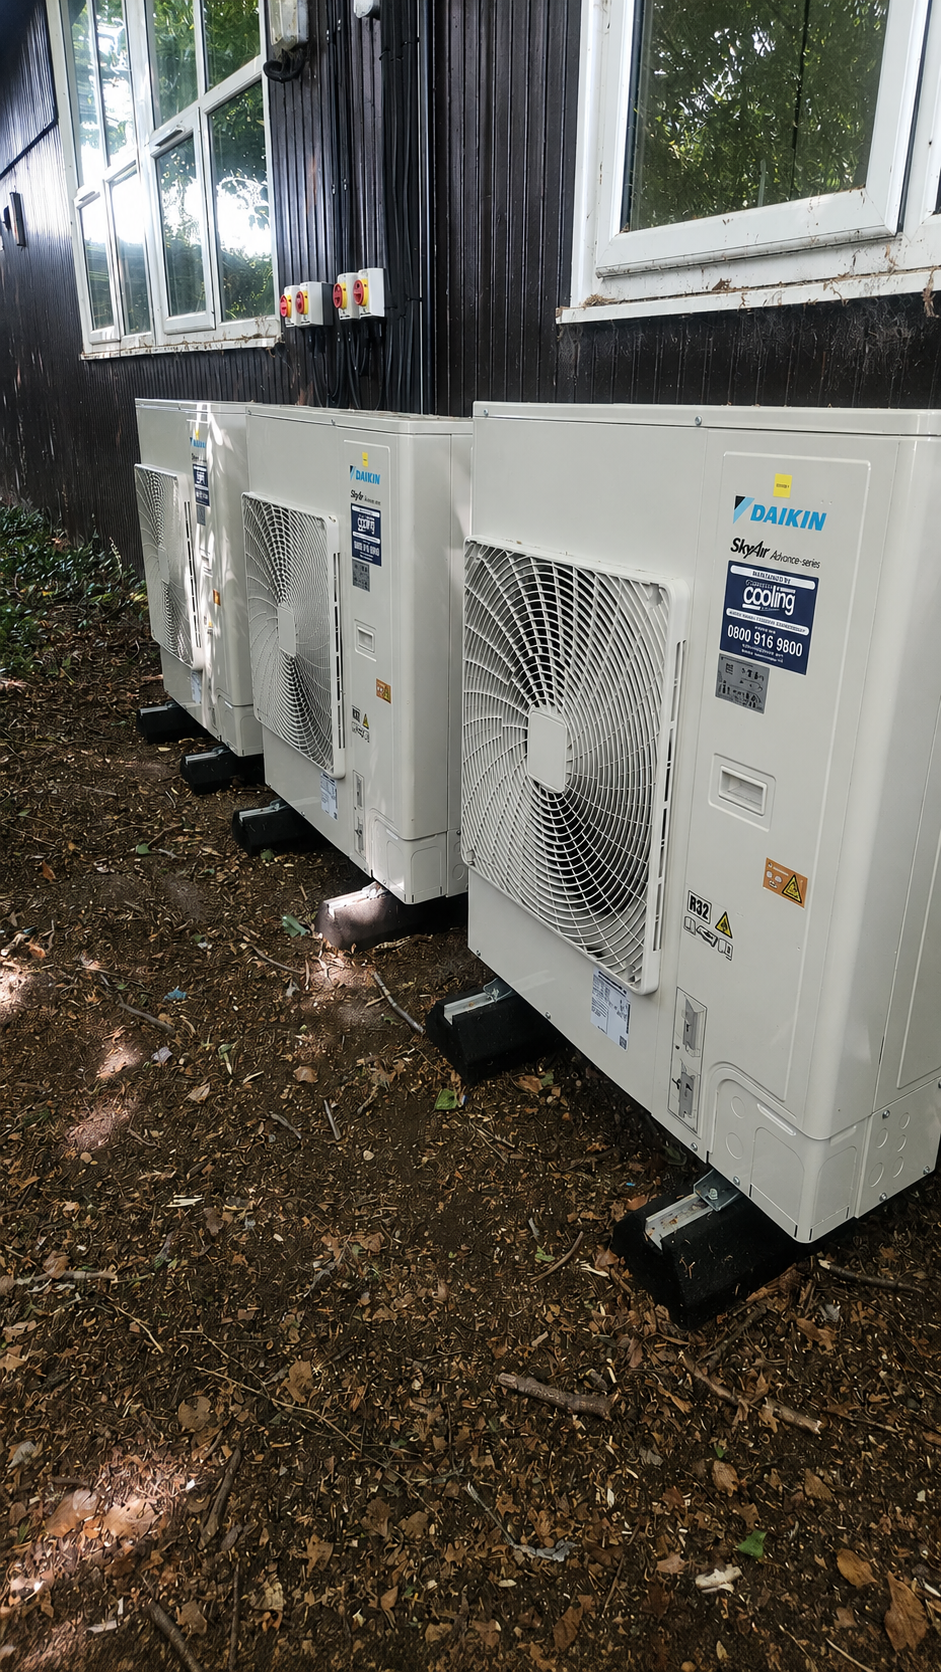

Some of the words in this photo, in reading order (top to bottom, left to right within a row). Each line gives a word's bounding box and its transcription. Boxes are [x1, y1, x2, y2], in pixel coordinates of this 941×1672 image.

[355, 469, 381, 485] DAIKIN
[750, 503, 828, 532] DAIKIN
[730, 537, 771, 559] SkyAir
[769, 550, 821, 569] Advance-series
[743, 585, 796, 616] cooling
[727, 624, 751, 643] 0800
[753, 631, 774, 649] 916
[776, 637, 803, 657] 9800
[689, 894, 709, 921] R32
